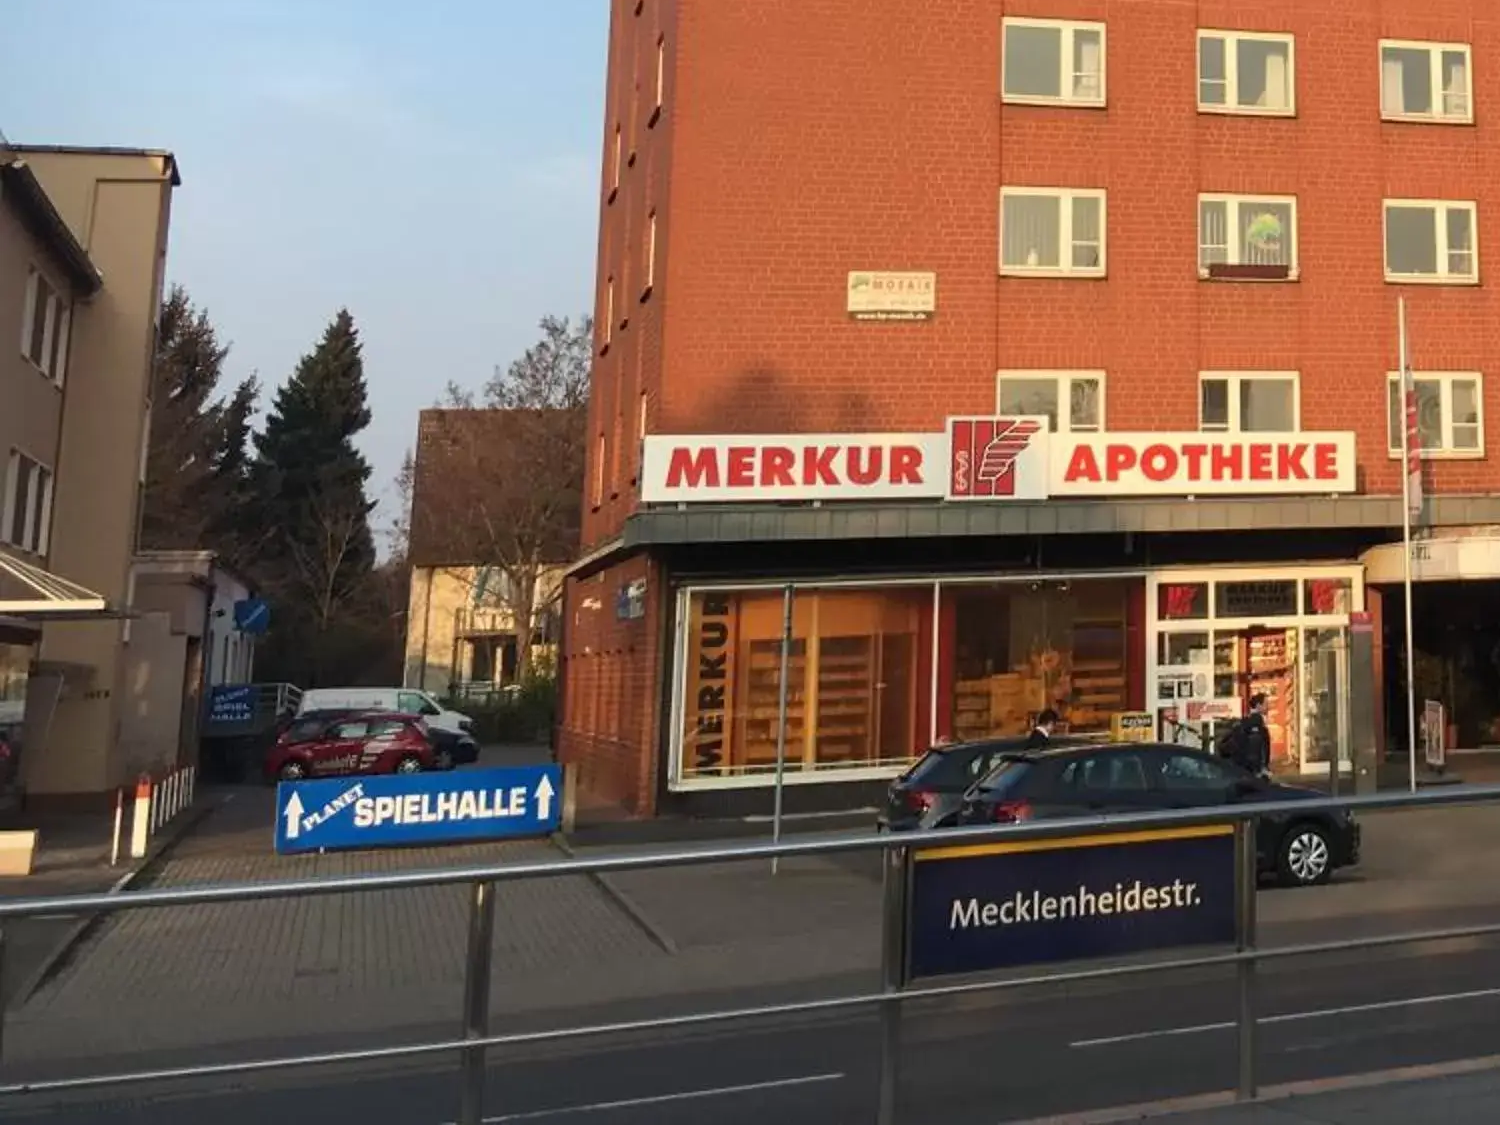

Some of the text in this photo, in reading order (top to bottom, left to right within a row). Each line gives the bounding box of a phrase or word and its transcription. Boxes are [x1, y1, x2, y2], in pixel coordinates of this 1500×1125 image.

[665, 445, 925, 488] MERKUR
[1063, 443, 1339, 482] APOTHEKE
[695, 592, 730, 776] MERKUR
[302, 783, 528, 832] PLANET SPIELHALLE
[949, 878, 1202, 930] Mecklenheidestr.
